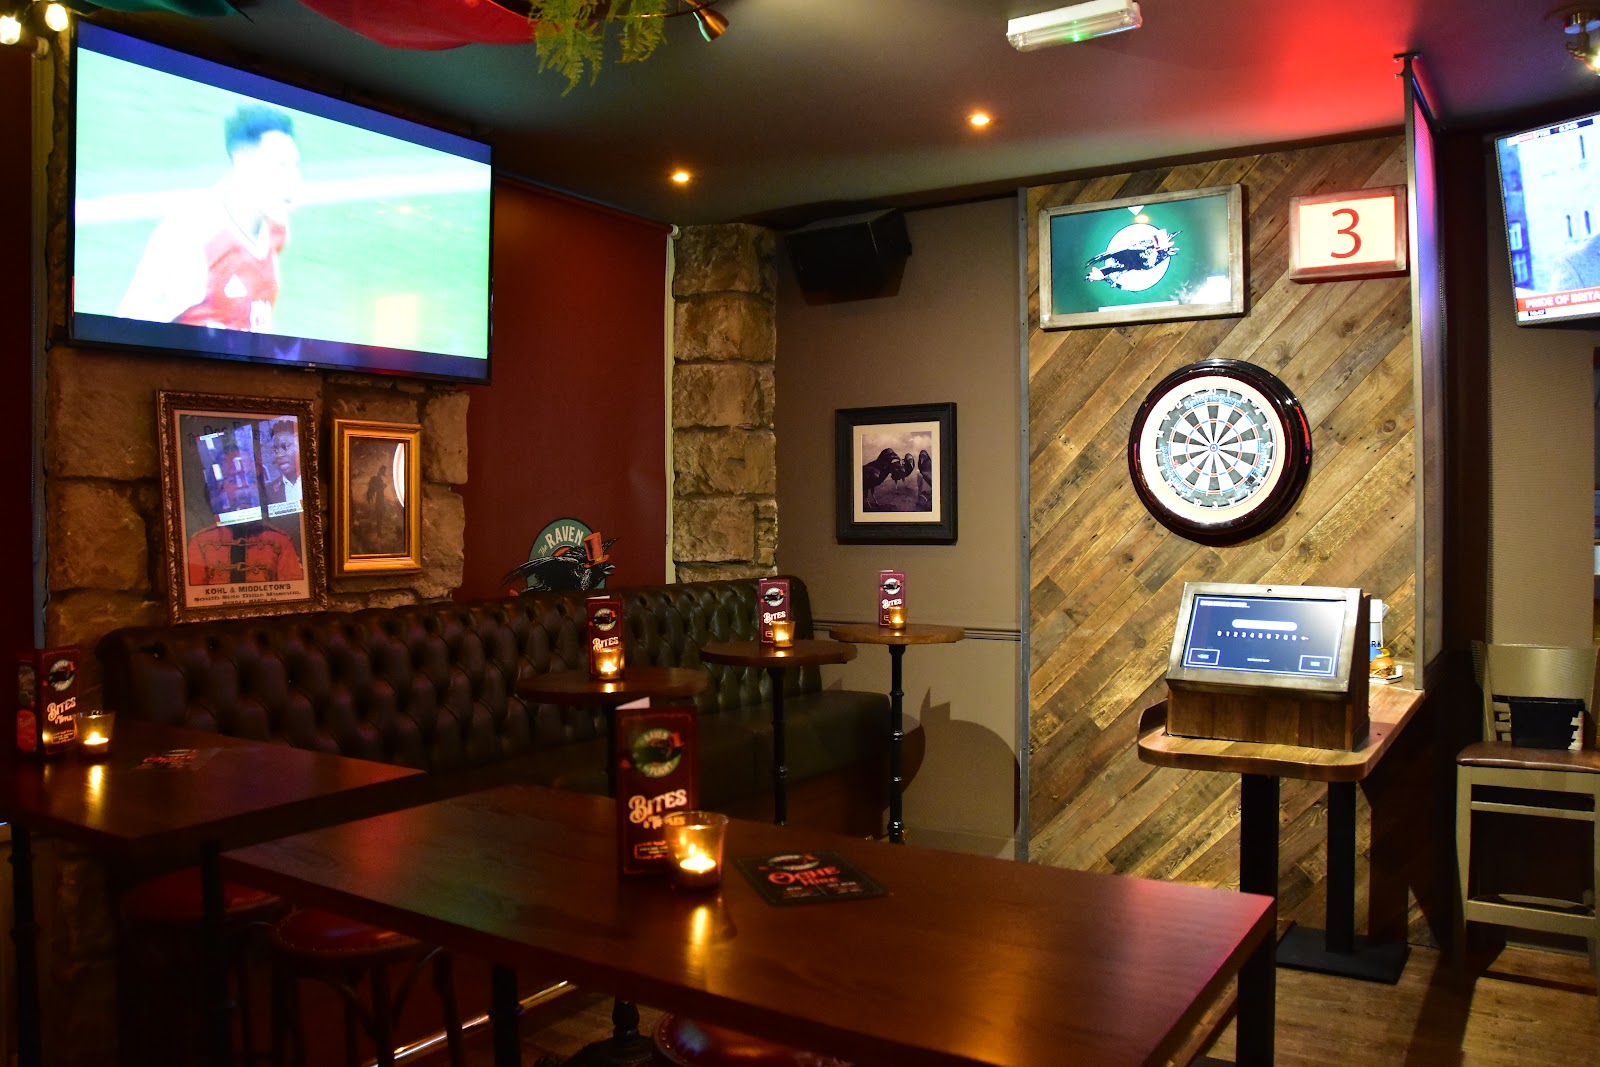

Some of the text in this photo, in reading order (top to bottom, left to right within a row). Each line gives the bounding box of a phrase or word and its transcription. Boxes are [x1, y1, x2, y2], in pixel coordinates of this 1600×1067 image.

[1330, 208, 1362, 259] 3
[1525, 296, 1554, 309] PRIDE
[1555, 294, 1569, 304] OF
[538, 526, 584, 557] The RAVEN
[238, 583, 291, 593] MIDDLETON'S
[763, 610, 786, 624] BITES
[592, 636, 619, 651] BITES
[47, 697, 77, 722] BITES
[628, 789, 688, 824] BITES
